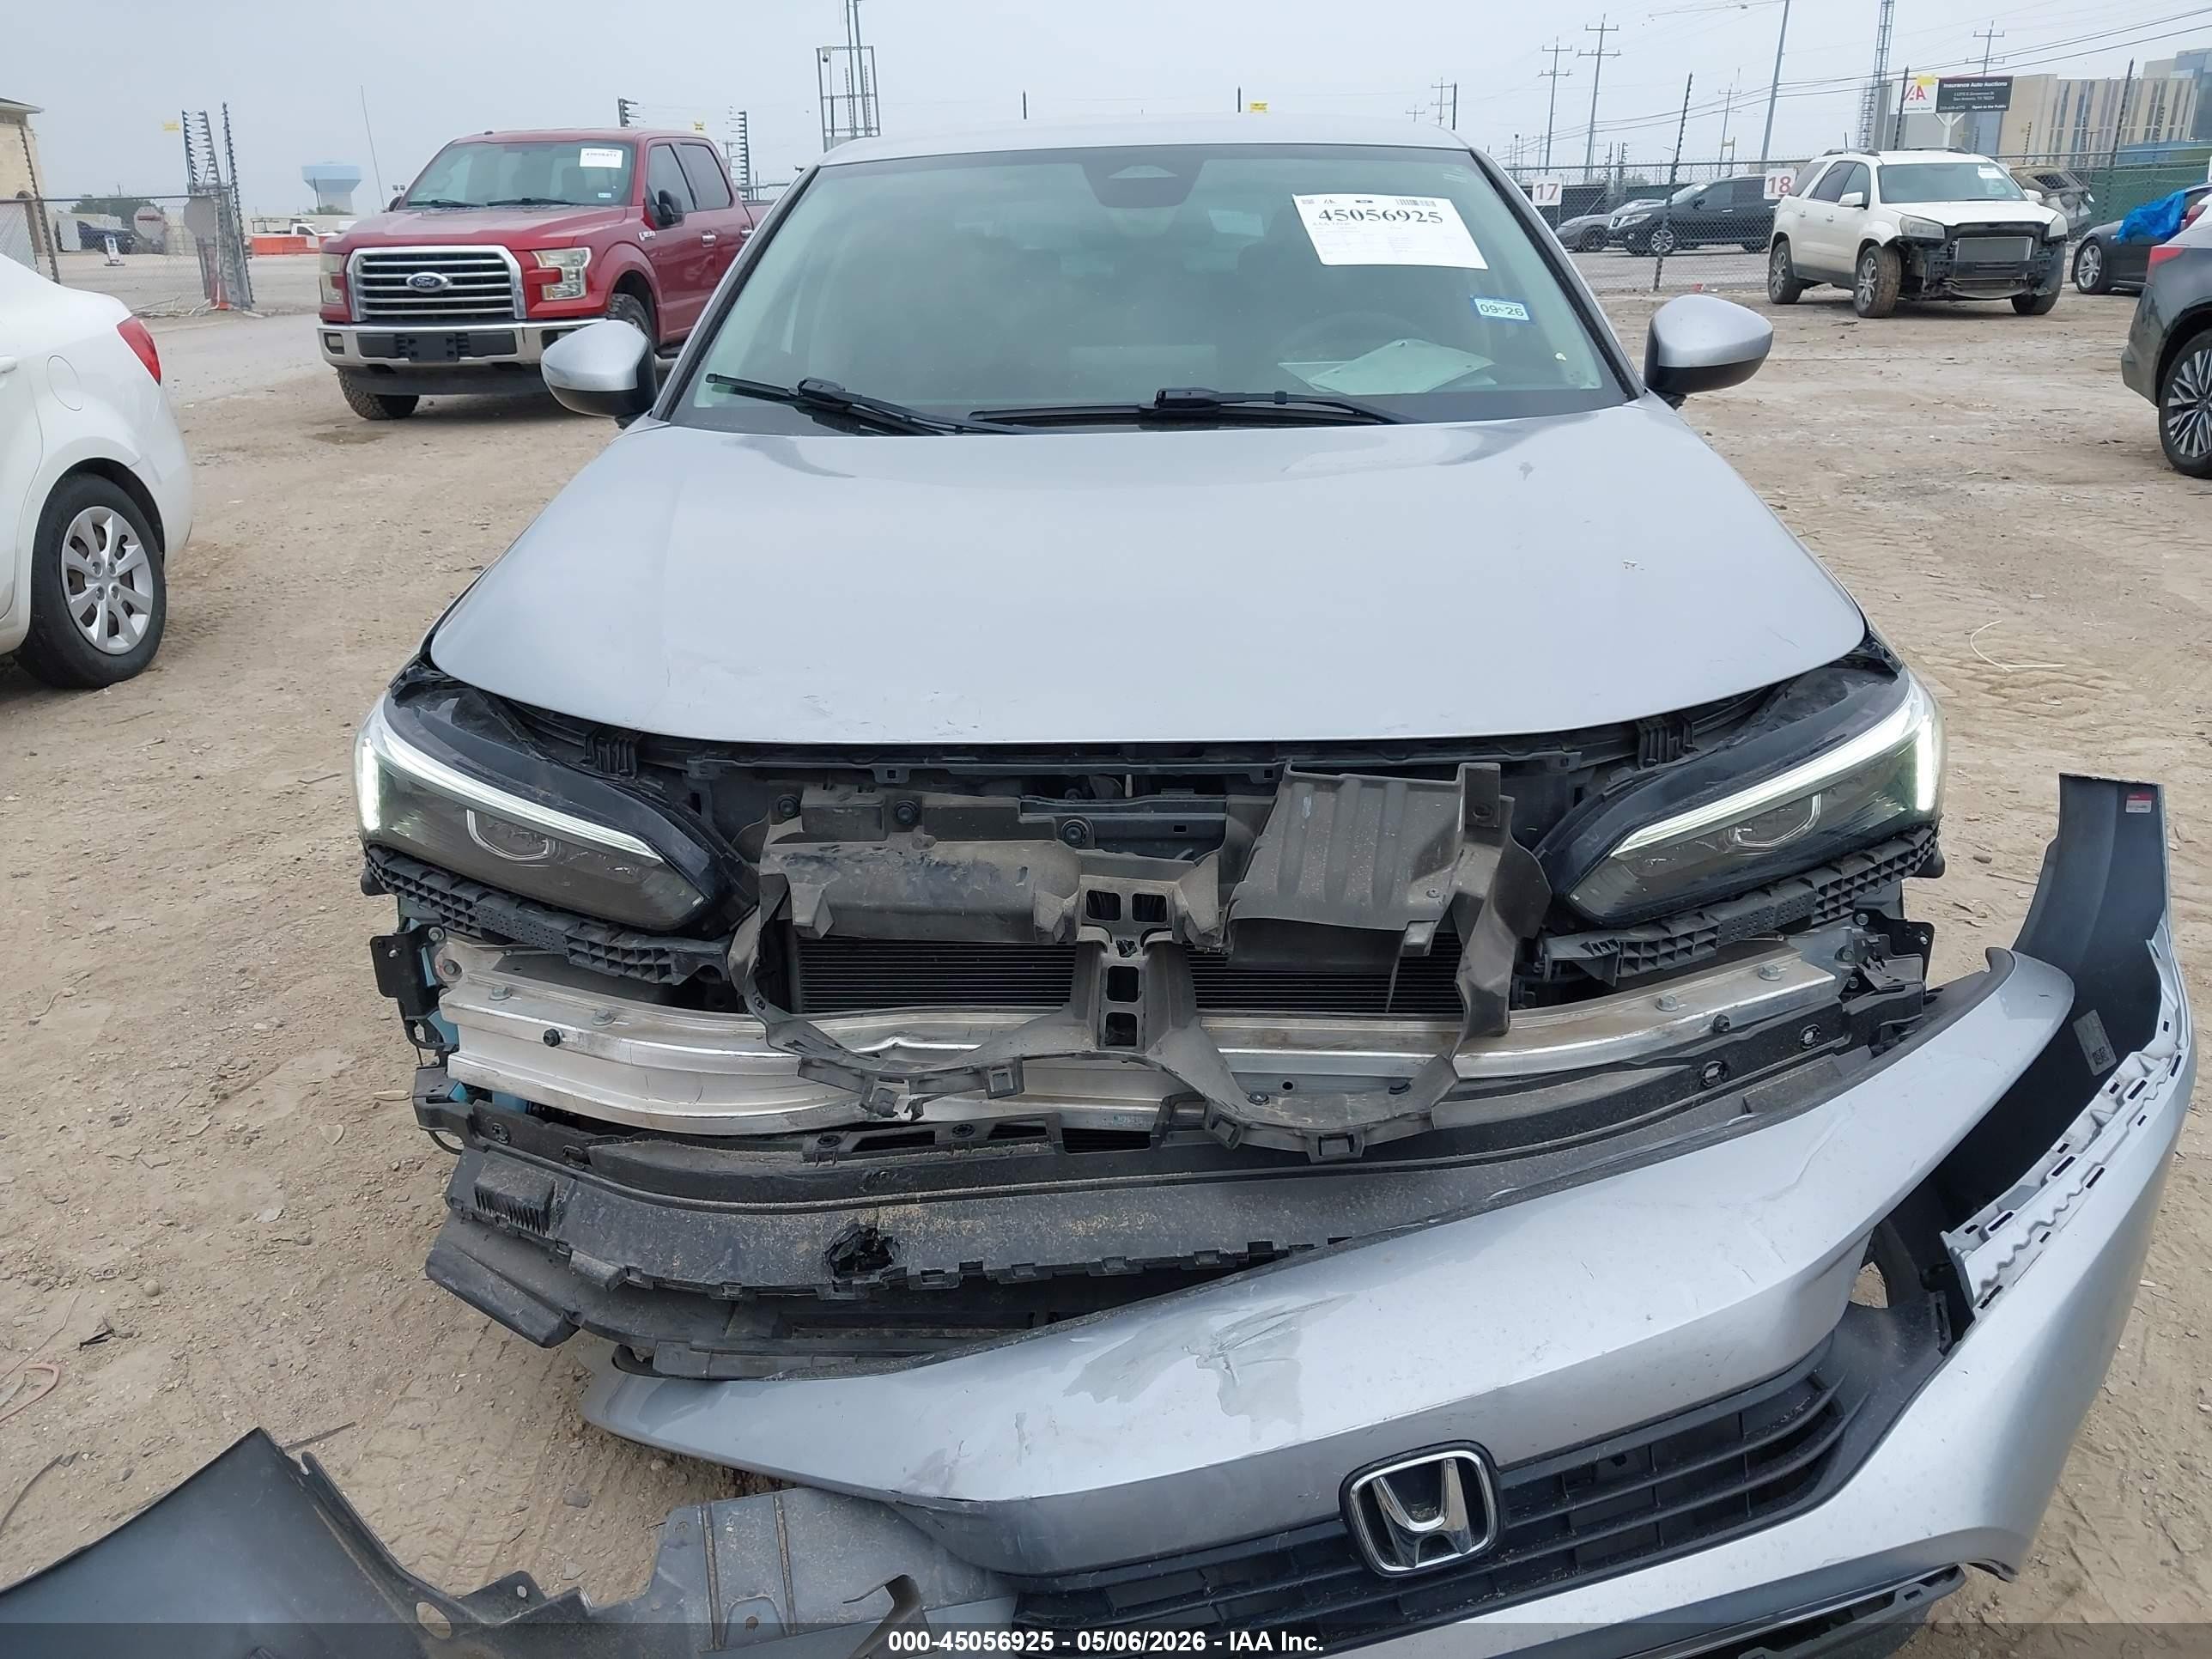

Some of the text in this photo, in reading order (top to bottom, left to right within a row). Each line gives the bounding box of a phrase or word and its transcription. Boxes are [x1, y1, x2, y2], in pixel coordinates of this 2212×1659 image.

[1535, 183, 1559, 201] 17
[1768, 175, 1791, 194] 18
[1319, 209, 1443, 224] 45056925
